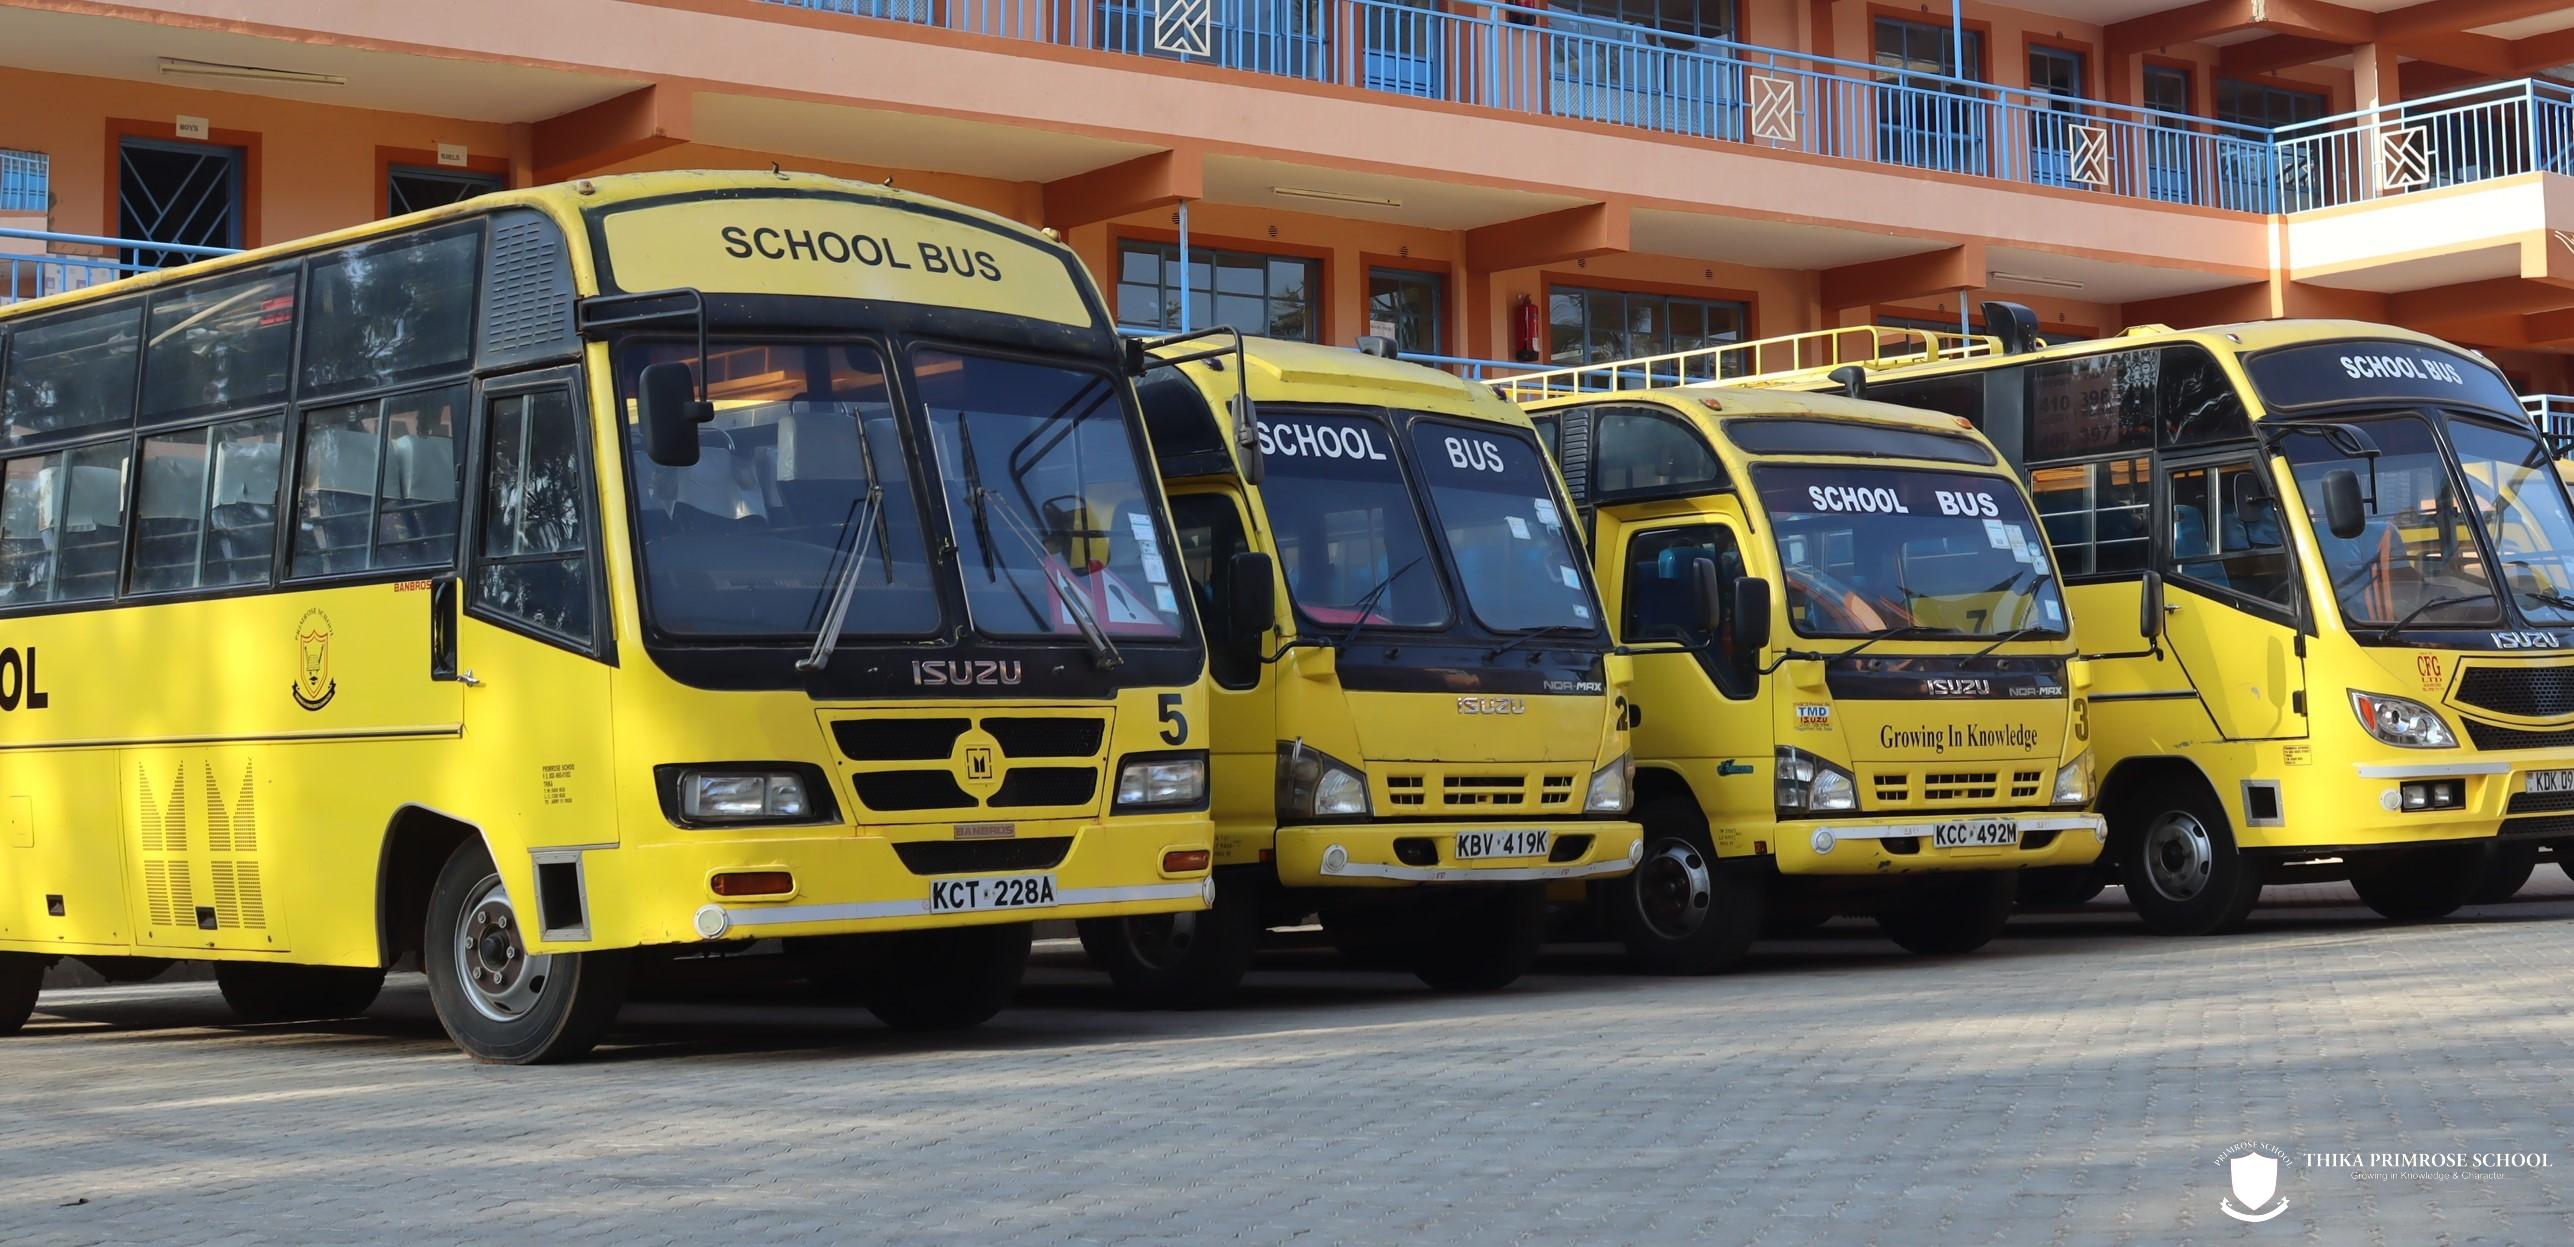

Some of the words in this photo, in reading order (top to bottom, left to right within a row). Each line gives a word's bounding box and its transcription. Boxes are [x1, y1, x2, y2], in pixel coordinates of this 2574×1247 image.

[721, 226, 912, 269] SCHOOL
[917, 241, 1002, 282] BUS
[2340, 355, 2428, 379] SCHOOL
[2421, 358, 2463, 385] BUS
[1257, 421, 1387, 460] SCHOOL
[1444, 436, 1504, 472] BUS
[1808, 485, 1910, 514] SCHOOL
[1935, 490, 1999, 517] BUS
[394, 581, 432, 592] BANBROS
[2490, 631, 2559, 648] ISUZU
[912, 660, 1023, 686] ISUZU
[2418, 656, 2441, 676] CFG
[1927, 679, 1990, 695] ISUZU
[1457, 697, 1526, 714] ISUZU
[1614, 695, 1629, 731] 2
[1798, 707, 1827, 716] TMD
[1157, 693, 1188, 746] 5
[1800, 716, 1828, 724] ISUZU
[2073, 698, 2089, 741] 3
[1880, 724, 1944, 754] Growing
[1948, 724, 1962, 747] In
[1967, 723, 2038, 752] Knowledge
[2536, 772, 2557, 791] KDK
[955, 825, 1014, 836] BANBROS
[1936, 824, 1968, 845] KCC
[1977, 823, 2017, 843] 492M
[1458, 834, 1493, 857] KBV
[1503, 831, 1547, 855] 419K
[933, 881, 979, 909] KCT
[994, 876, 1054, 906] 228A
